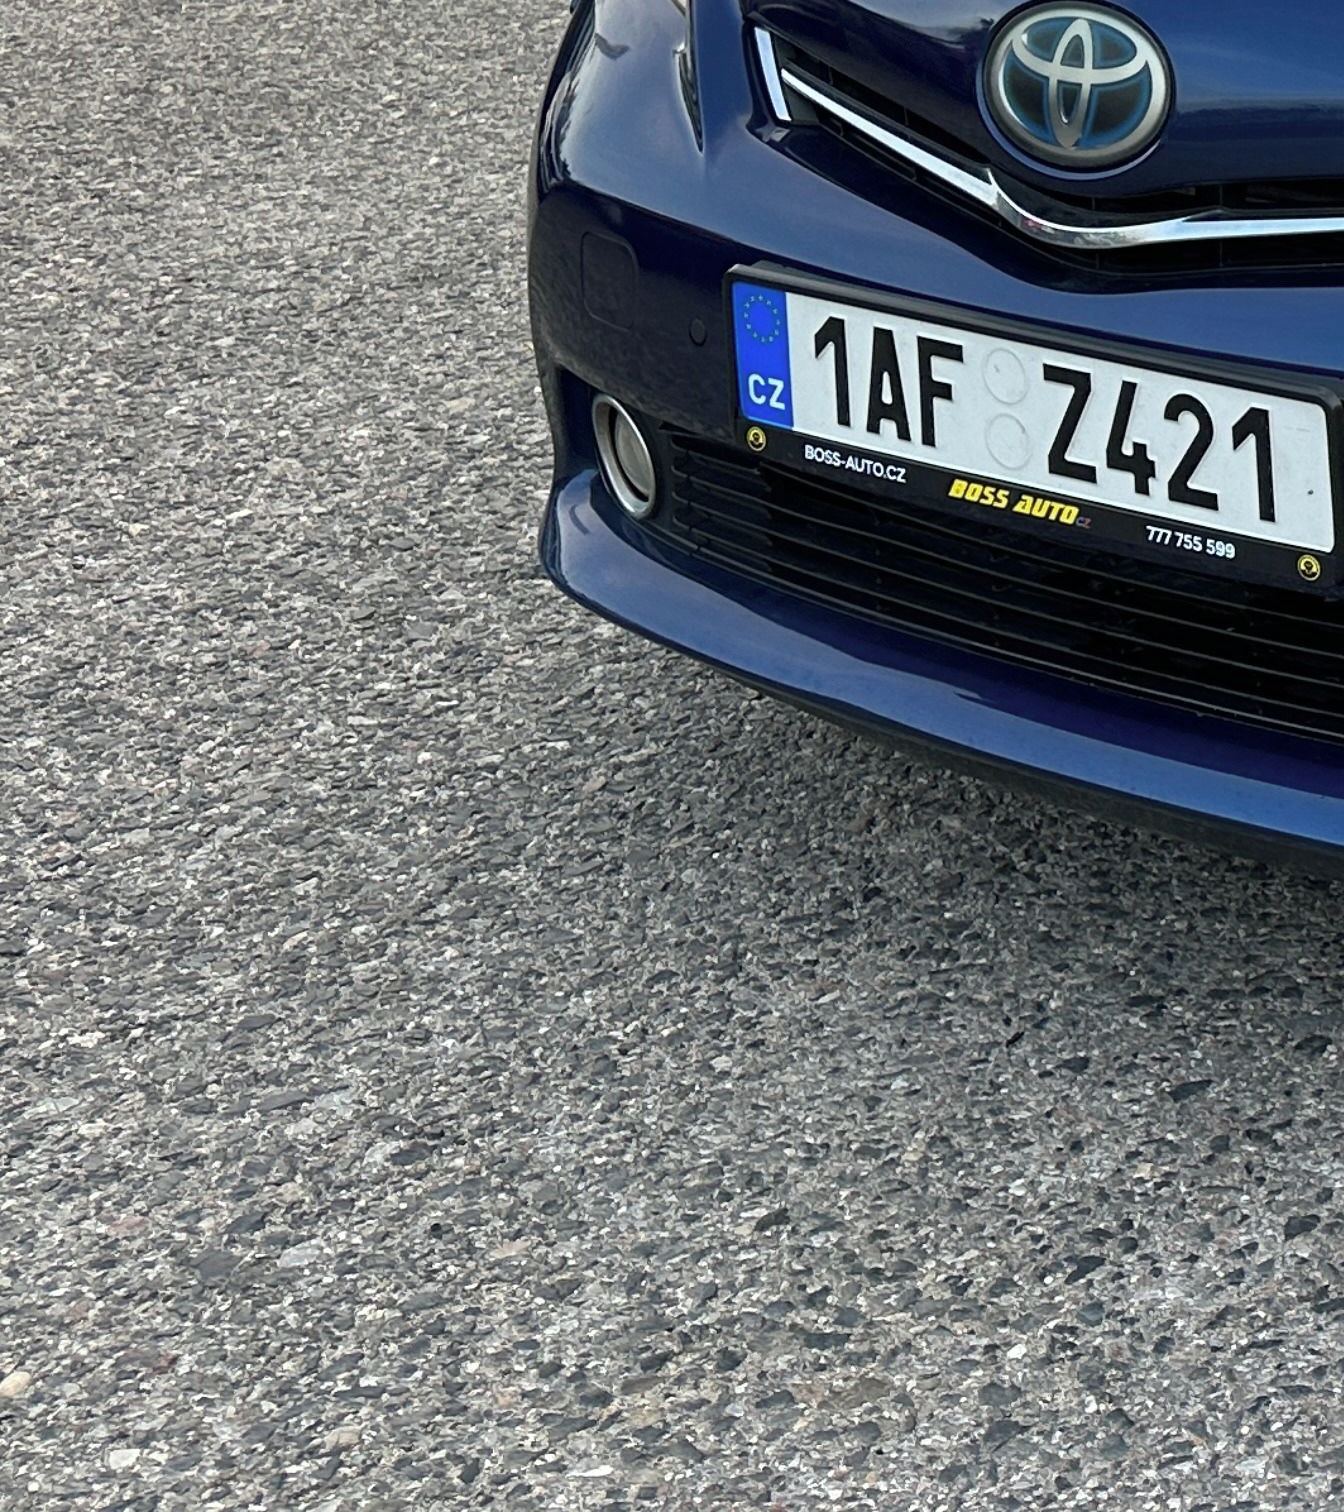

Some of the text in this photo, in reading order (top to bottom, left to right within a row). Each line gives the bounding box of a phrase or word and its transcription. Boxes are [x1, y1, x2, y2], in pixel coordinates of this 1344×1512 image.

[748, 373, 786, 410] CZ
[814, 315, 1276, 523] 1AF Z421
[804, 444, 907, 484] BOSS-AUTO.CZ
[948, 478, 1010, 509] BOSS
[1011, 493, 1080, 525] AUTO
[1146, 525, 1236, 560] 777 755 599
